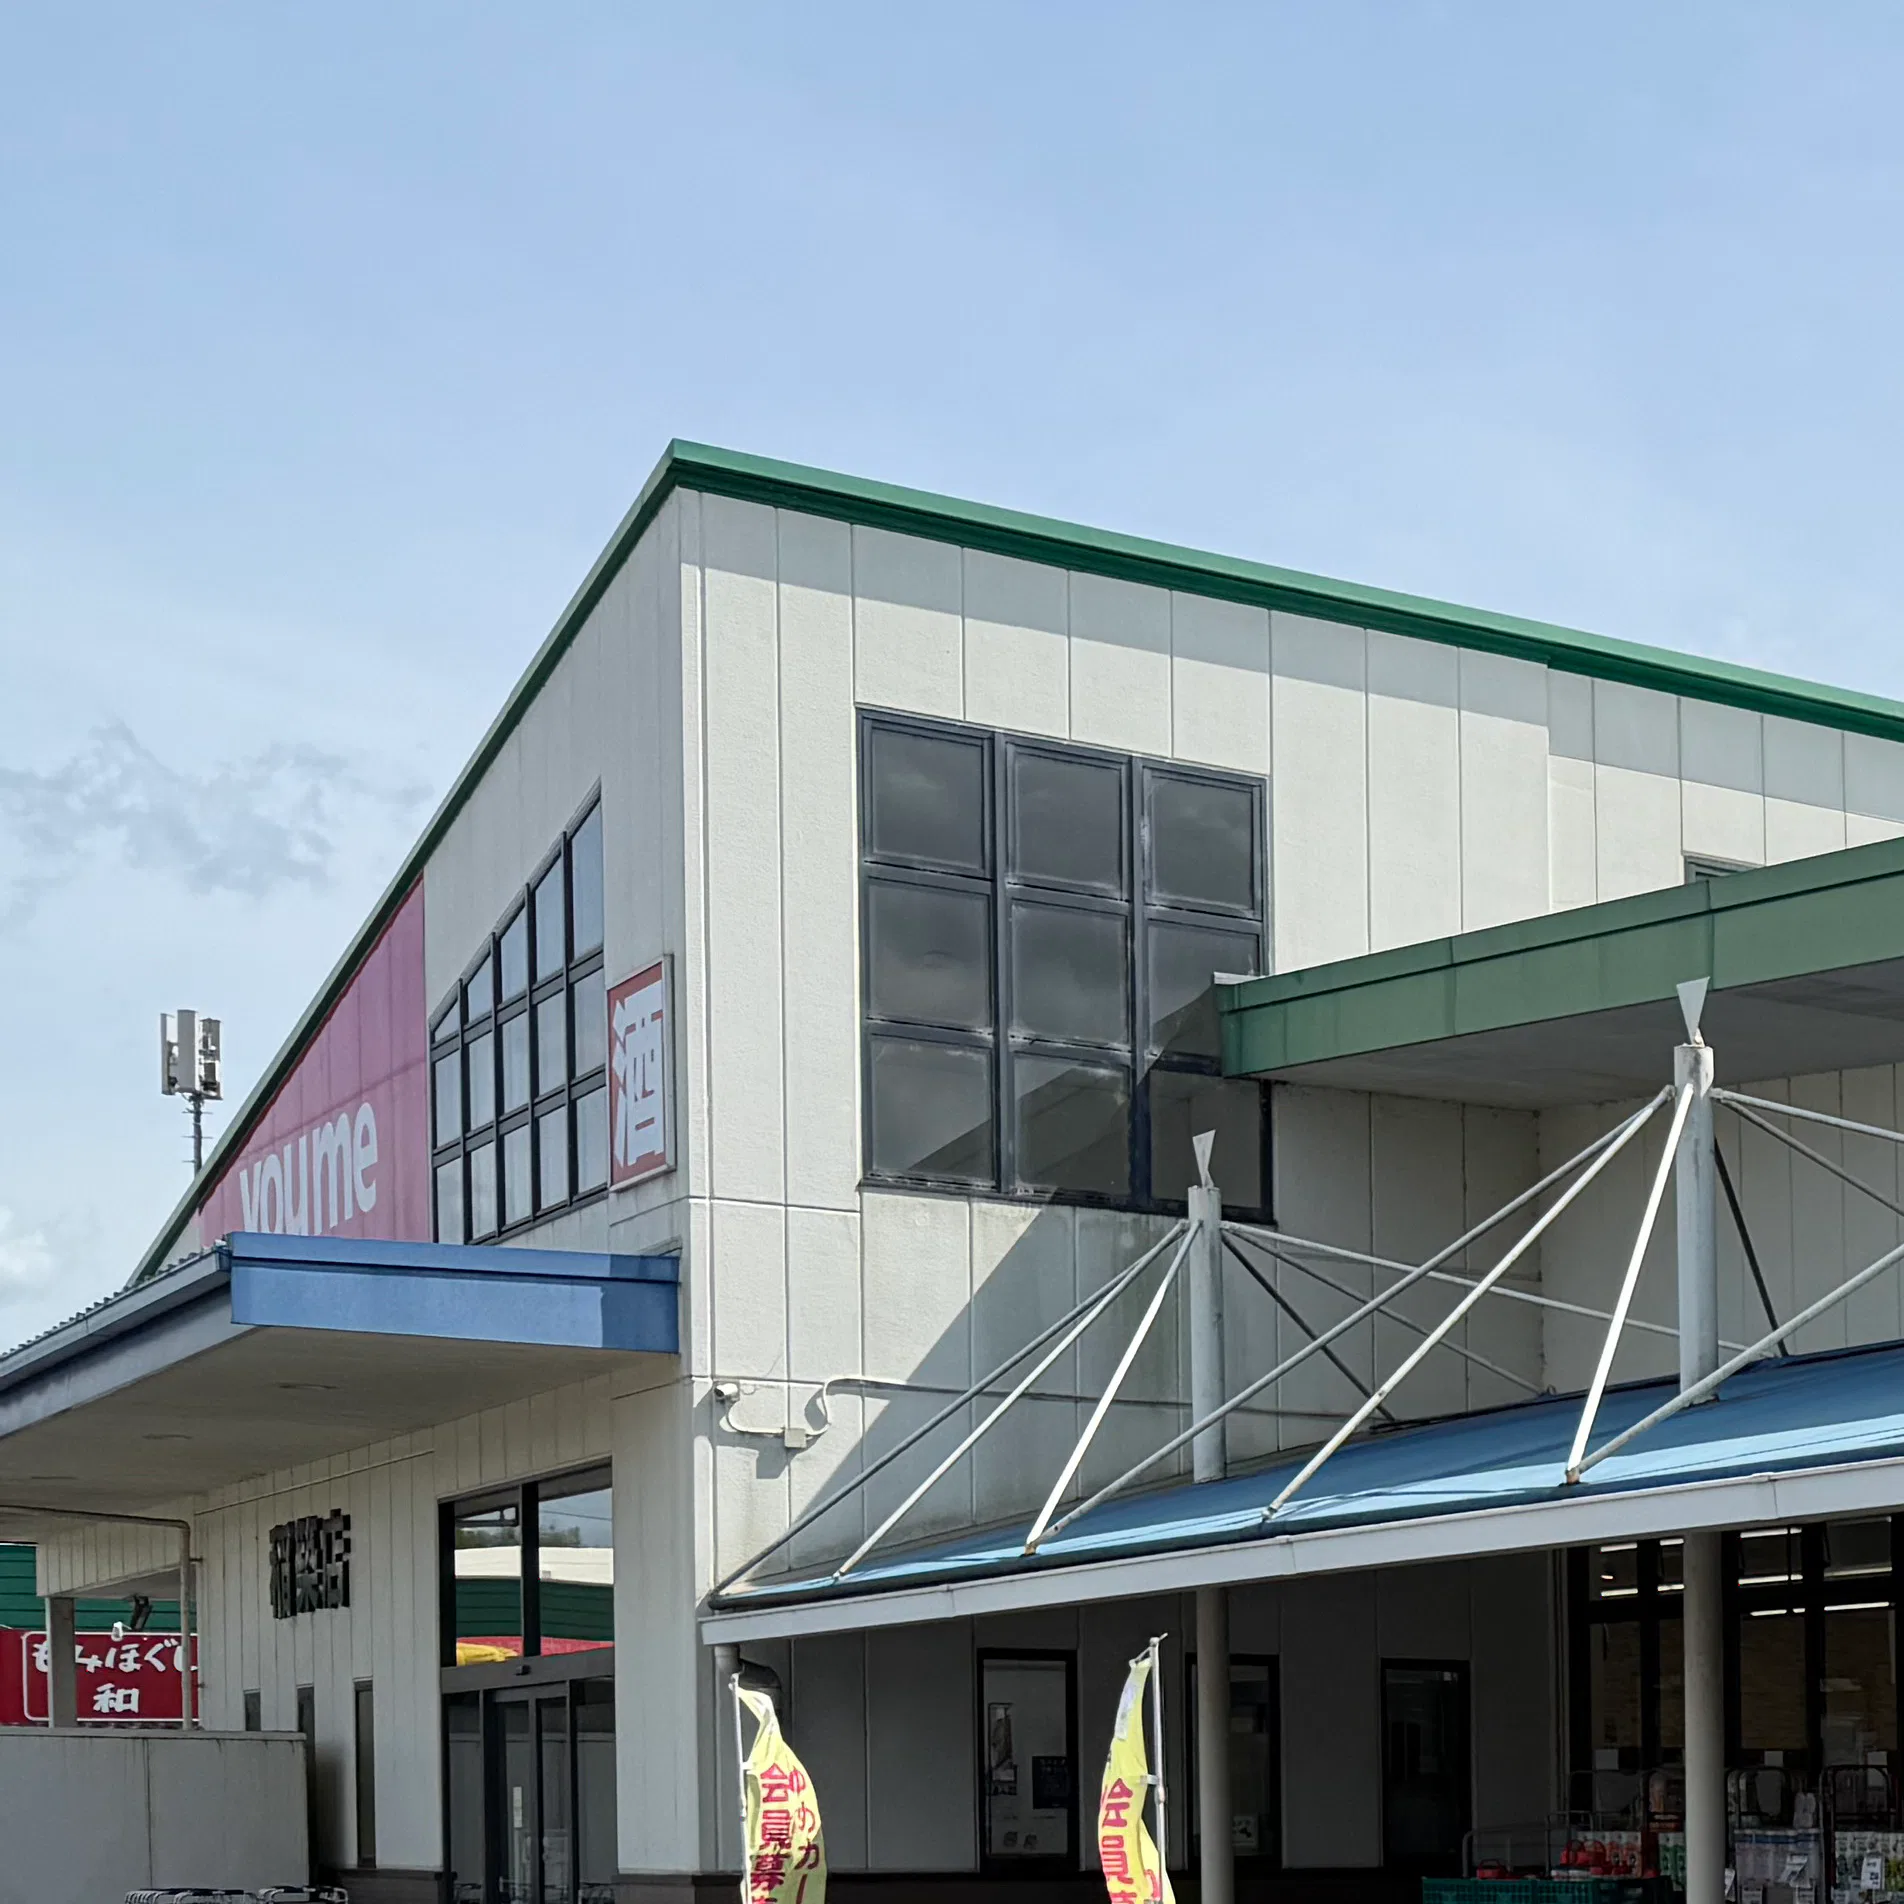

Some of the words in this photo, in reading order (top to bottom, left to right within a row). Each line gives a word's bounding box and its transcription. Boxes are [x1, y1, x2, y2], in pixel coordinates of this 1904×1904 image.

[611, 1000, 663, 1170] 酒
[240, 1101, 379, 1235] youme
[92, 1682, 140, 1714] 和
